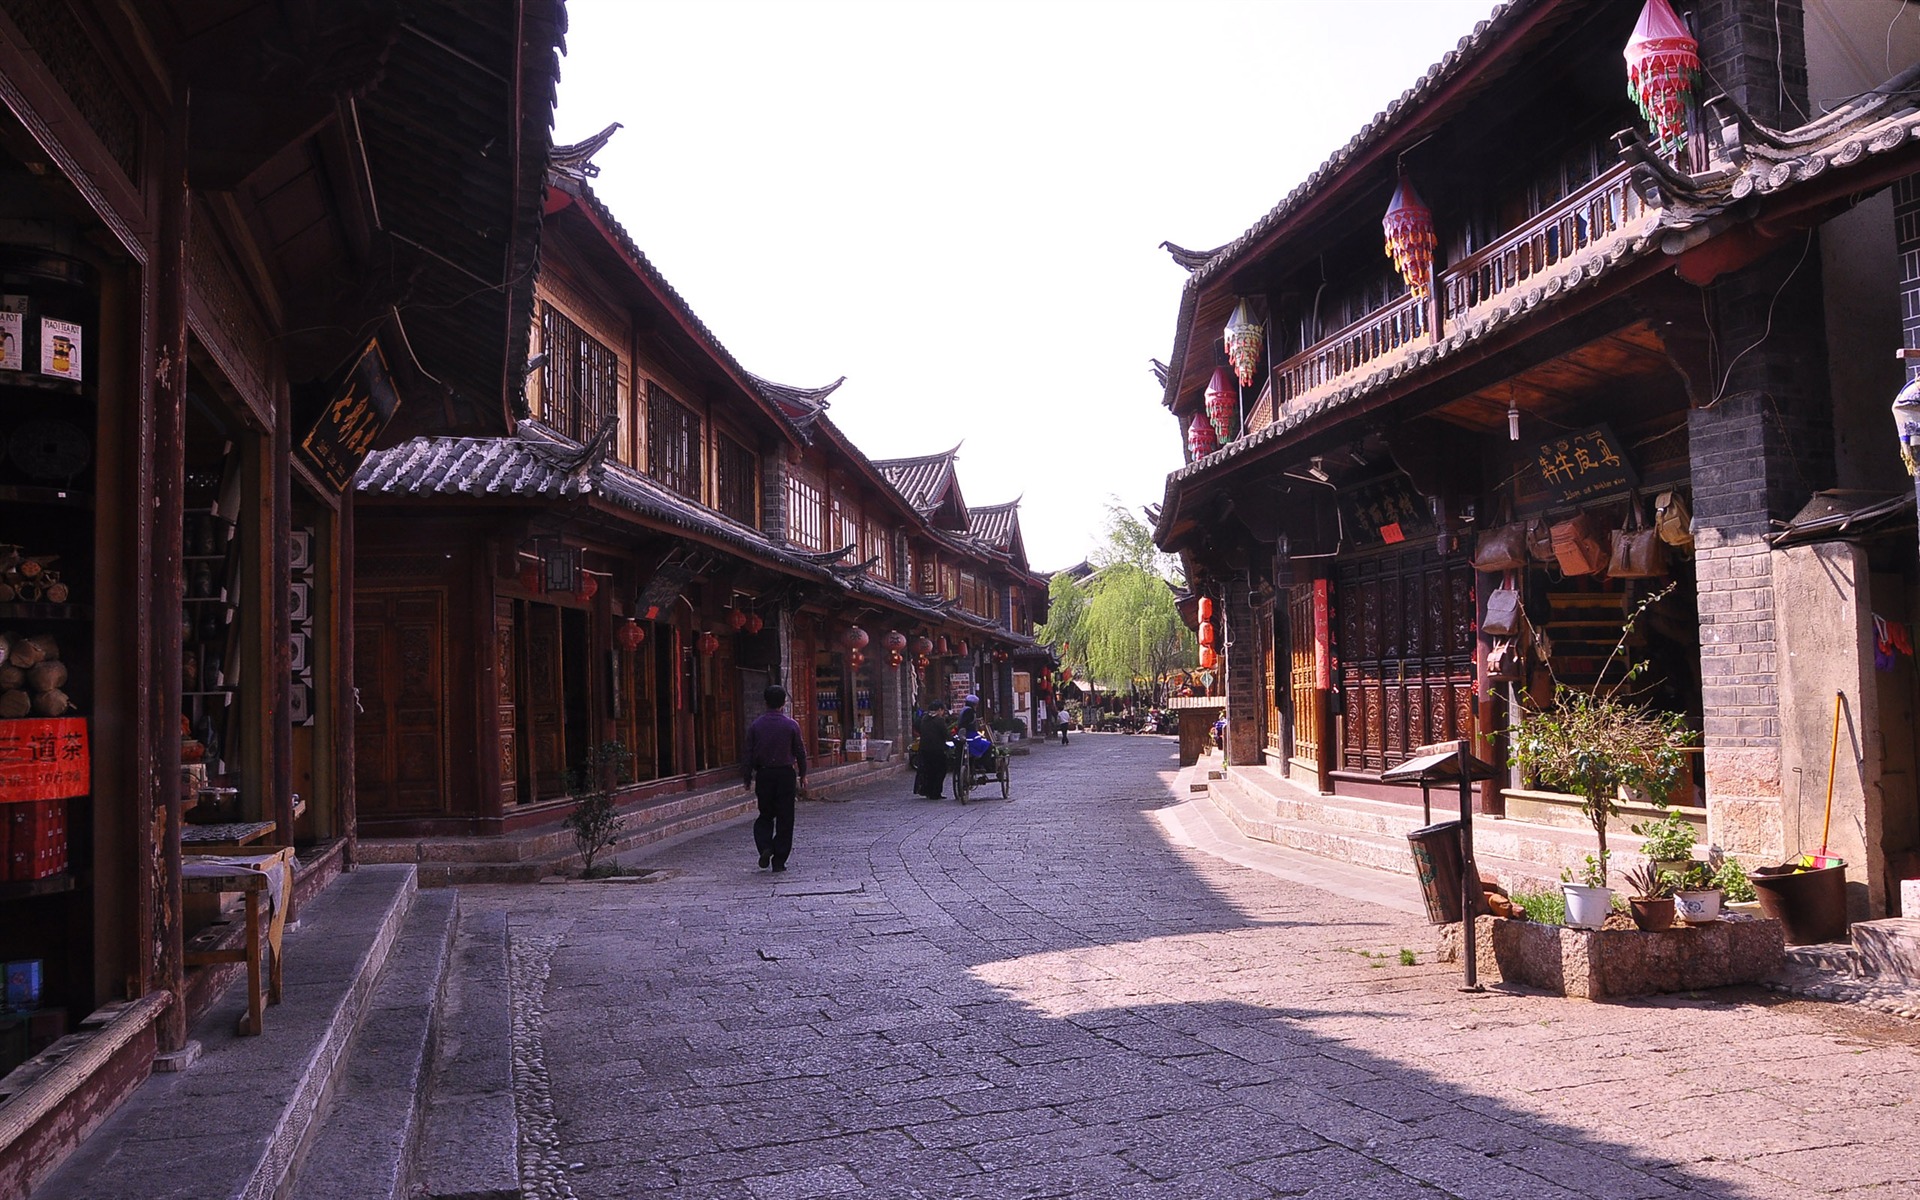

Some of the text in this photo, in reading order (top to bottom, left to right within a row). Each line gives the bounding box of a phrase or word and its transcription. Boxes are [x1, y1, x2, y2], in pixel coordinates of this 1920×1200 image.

[61, 323, 70, 332] TEA
[0, 731, 82, 762] 三道茶
